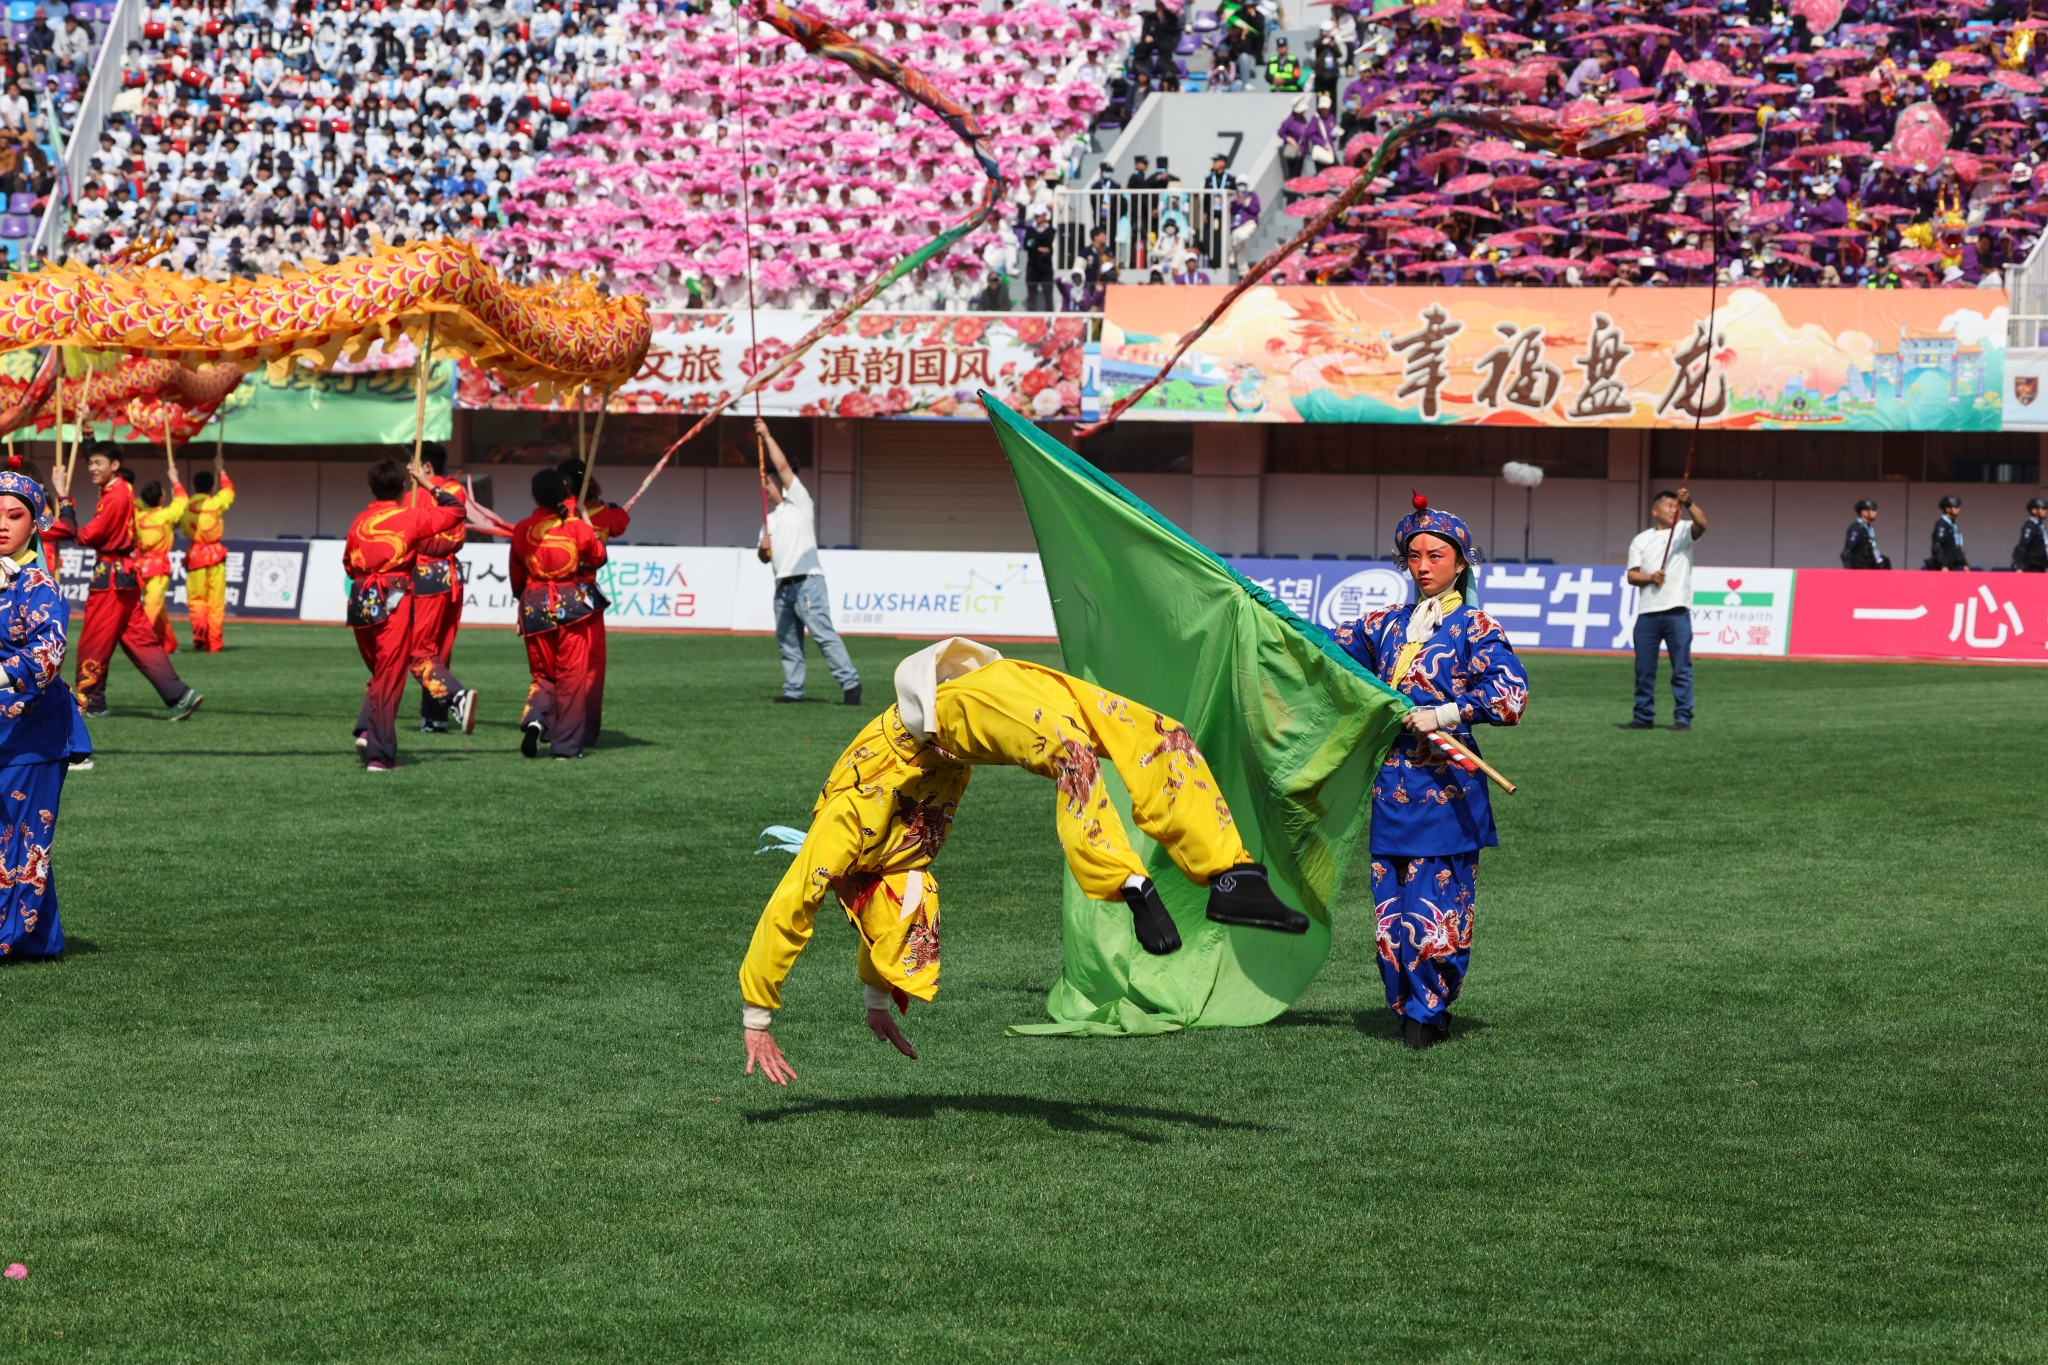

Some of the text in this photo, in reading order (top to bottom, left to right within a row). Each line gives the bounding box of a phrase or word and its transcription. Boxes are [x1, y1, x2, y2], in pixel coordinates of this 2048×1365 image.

[1217, 131, 1244, 168] 7
[637, 344, 996, 388] 文旅 滇韵国风
[1391, 303, 1728, 418] 幸福盘龙
[843, 593, 1005, 614] LUXSHARE ICT
[1728, 610, 1774, 622] Health
[1853, 584, 2048, 649] 一心
[1692, 624, 1771, 645] 一心堂
